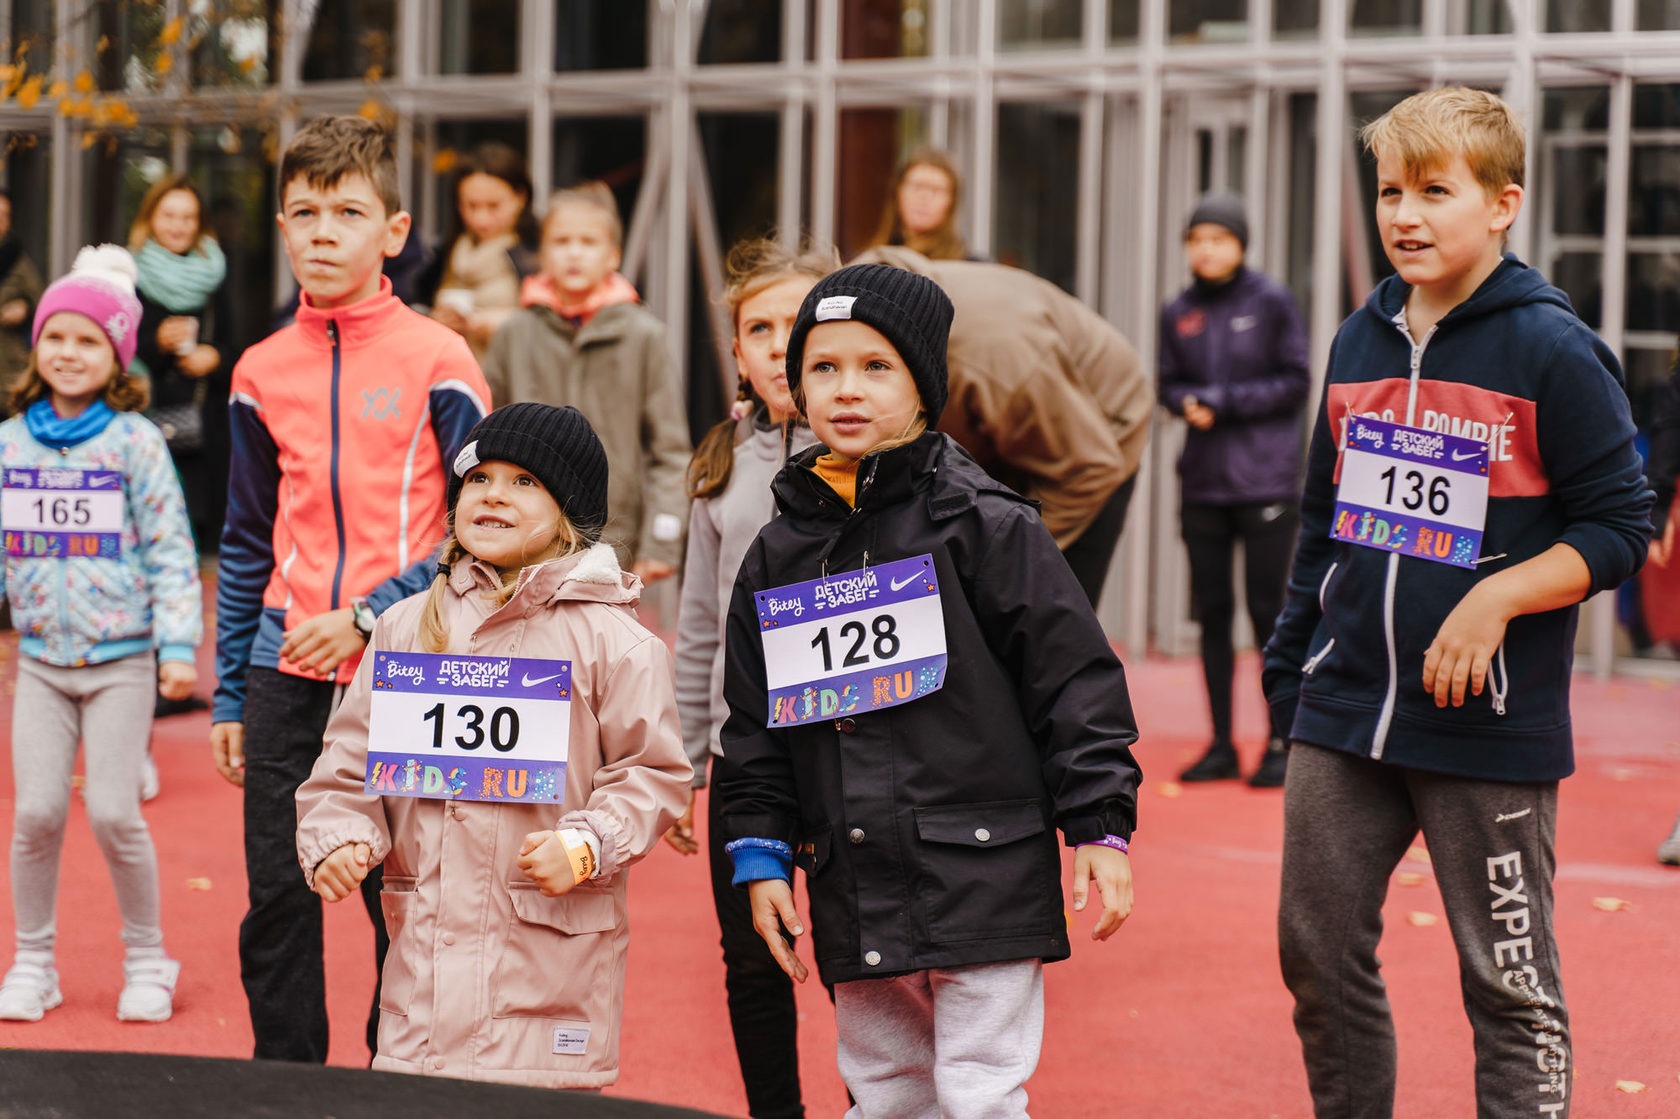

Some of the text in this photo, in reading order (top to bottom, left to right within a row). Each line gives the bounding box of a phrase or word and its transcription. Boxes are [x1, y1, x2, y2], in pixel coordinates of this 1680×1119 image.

[1393, 429, 1444, 450] ДЕТСКИЙ
[1380, 465, 1451, 516] 136
[33, 498, 91, 525] 165
[814, 571, 878, 601] ДЕТСКИЙ
[768, 597, 805, 617] Bitey
[828, 588, 869, 609] ЗАБЕГ
[811, 614, 900, 672] 128
[387, 662, 426, 686] Bitey
[439, 660, 510, 677] ДЕТСКИЙ
[451, 674, 498, 688] ЗАБЕГ
[423, 702, 520, 752] 130
